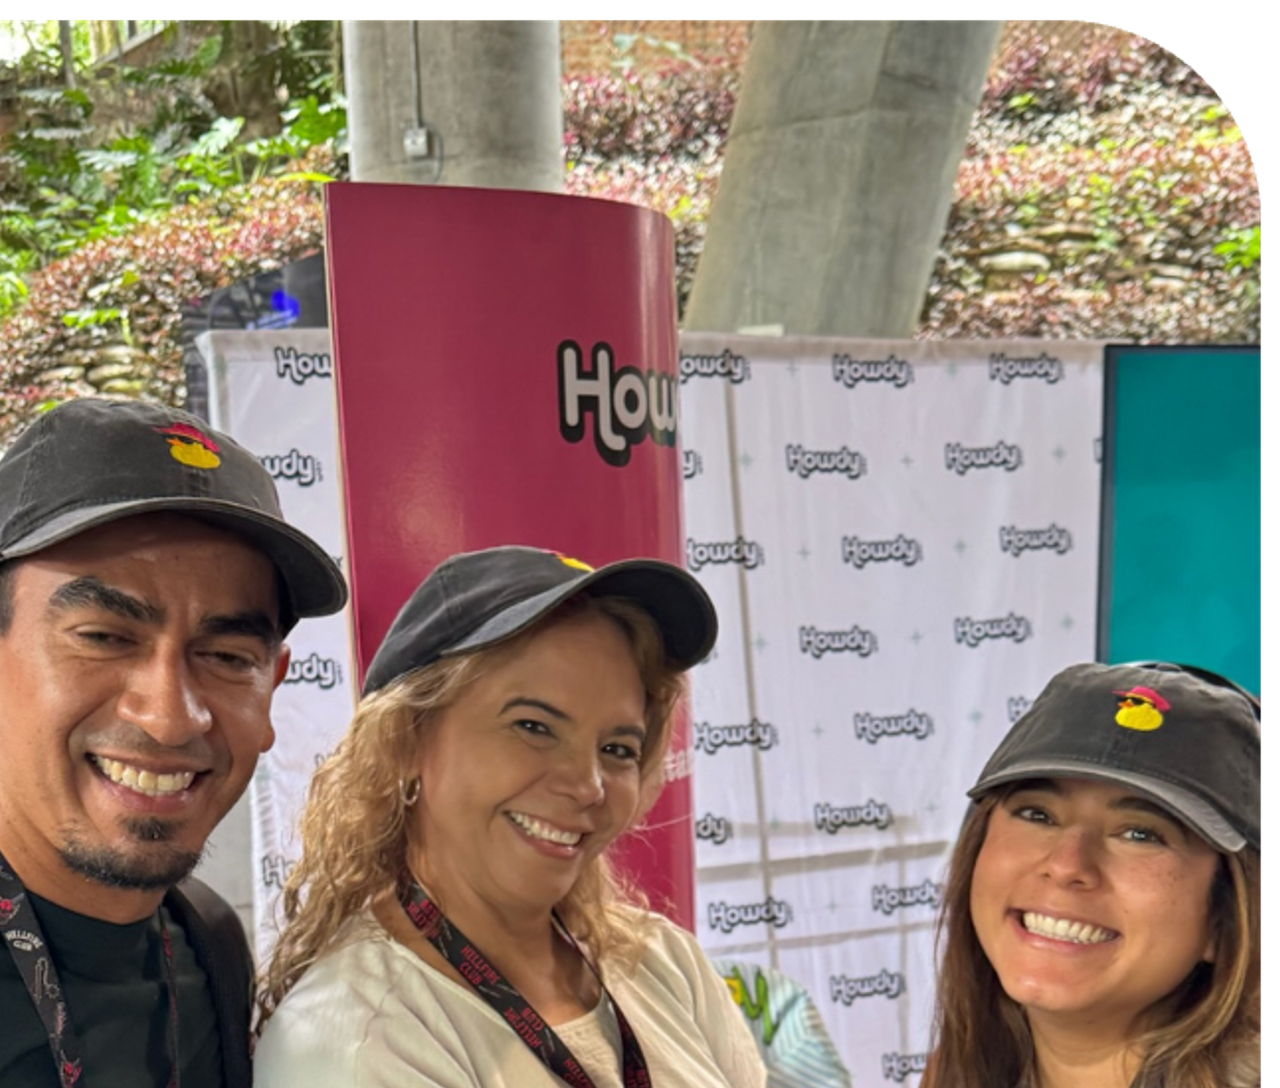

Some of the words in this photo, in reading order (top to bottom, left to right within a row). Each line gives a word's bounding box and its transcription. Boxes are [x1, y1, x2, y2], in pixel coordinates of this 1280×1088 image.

[680, 349, 743, 384] owdy
[832, 352, 910, 388] Howdy
[989, 352, 1060, 383] Howdy
[785, 444, 863, 479] Howdy
[945, 441, 1020, 475] Howdy
[842, 534, 919, 568] Howdy
[999, 523, 1070, 556] Howdy
[799, 625, 874, 658] Howdy
[954, 612, 1028, 648] Howdy
[694, 718, 773, 754] Howdy
[854, 709, 930, 743] Howdy
[814, 799, 890, 834] Howdy
[709, 897, 788, 933] Howdy
[5, 929, 44, 950] HELLFIRE
[458, 962, 483, 986] CLUB
[460, 945, 500, 985] HELLFIRE
[830, 969, 900, 1006] Howdy
[504, 1009, 543, 1049] HELLFIRE
[520, 1006, 544, 1031] CLUB
[882, 1052, 928, 1082] How
